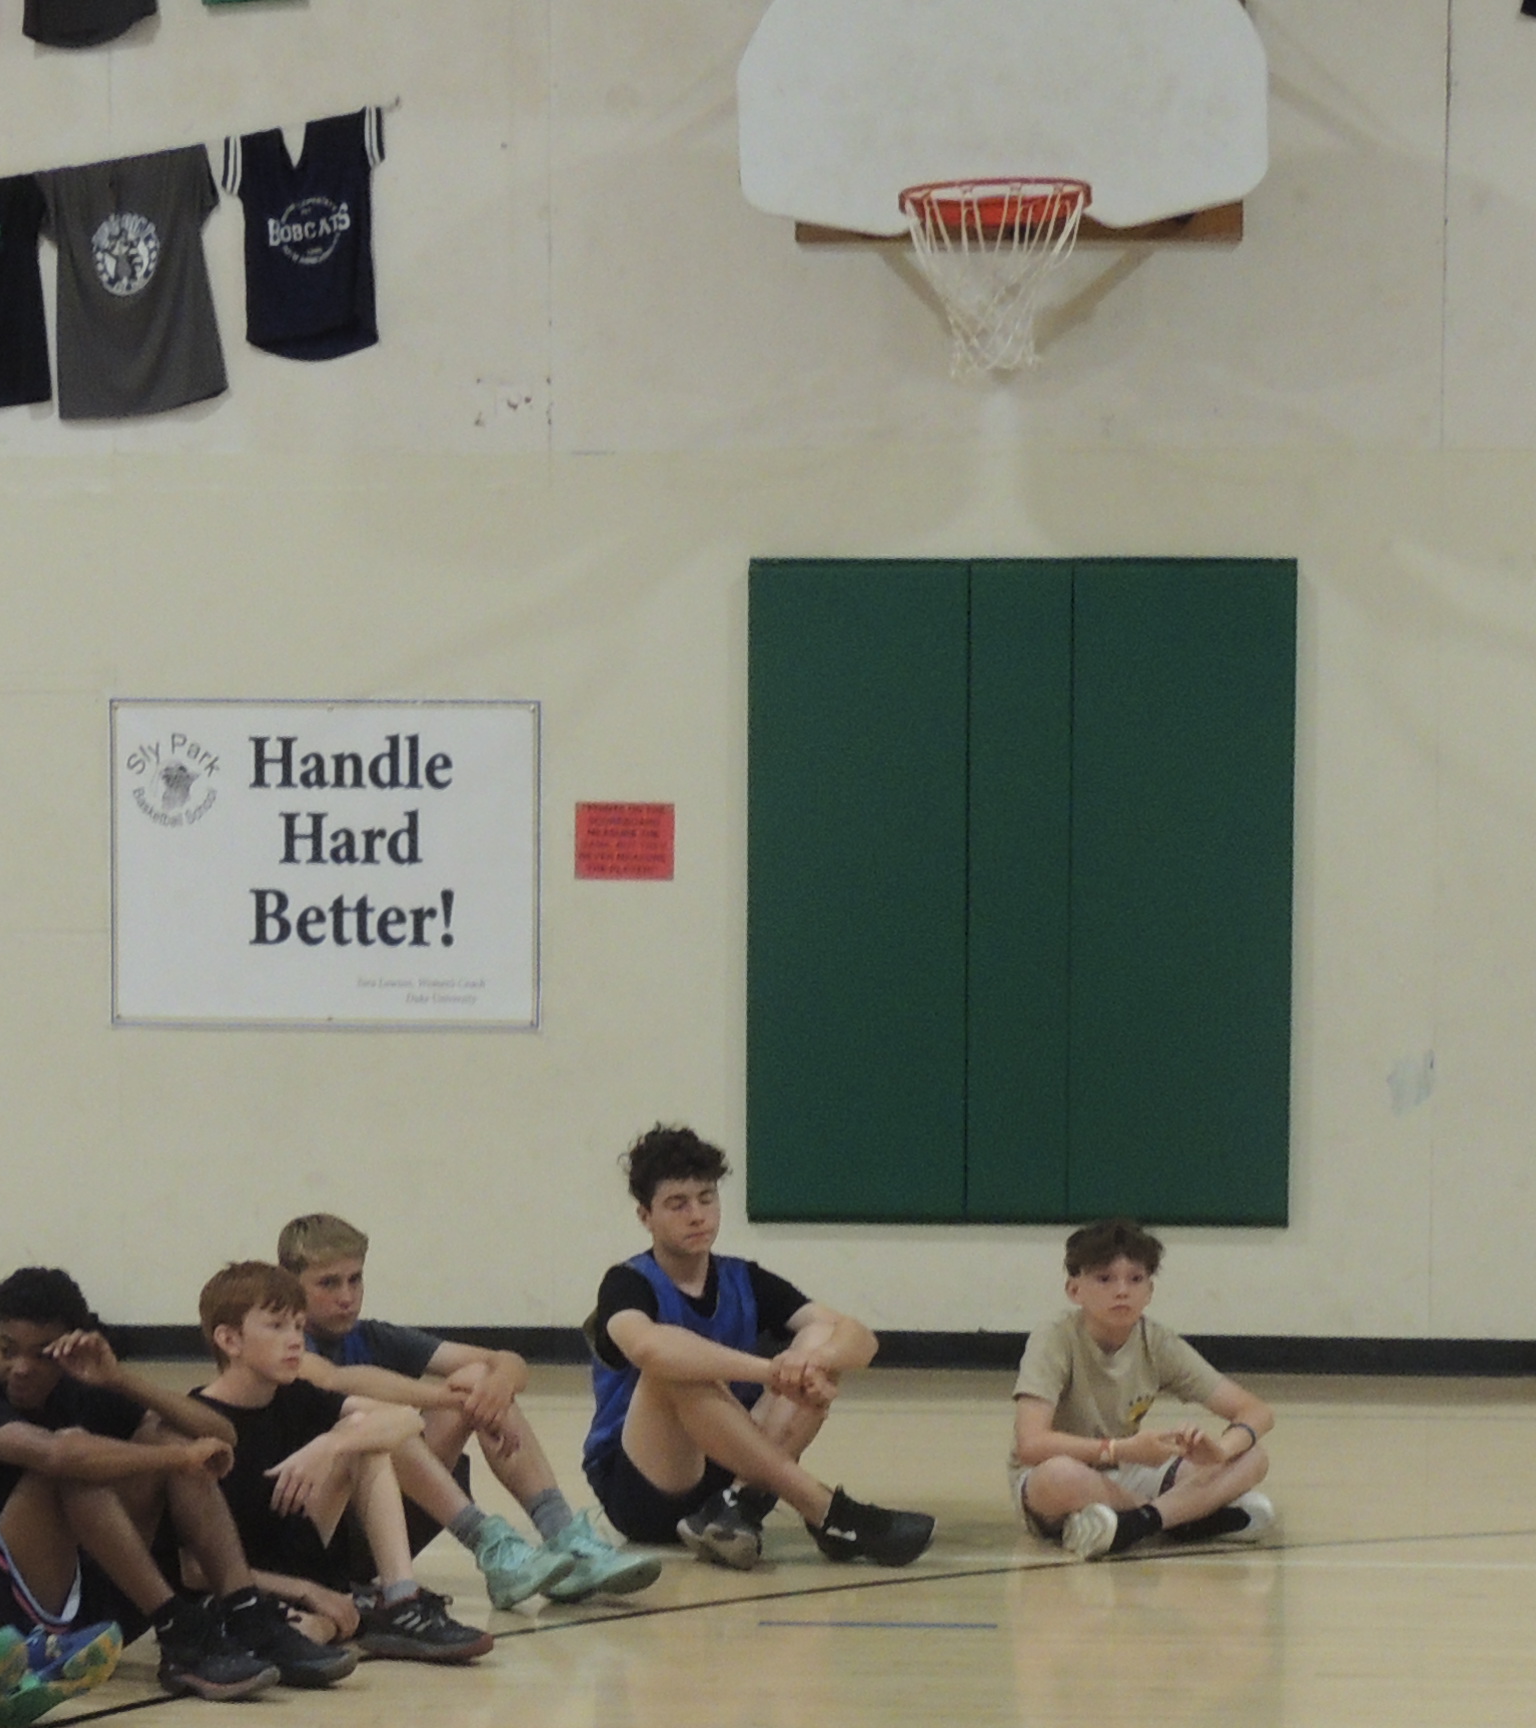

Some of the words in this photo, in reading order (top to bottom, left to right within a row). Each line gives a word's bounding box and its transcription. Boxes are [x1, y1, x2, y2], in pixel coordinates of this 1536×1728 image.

[268, 202, 350, 246] BOBCATS
[126, 742, 160, 775] Sly
[171, 732, 220, 777] Park
[249, 733, 453, 790] Handle
[279, 808, 423, 866] Hard
[249, 887, 455, 948] Better!
